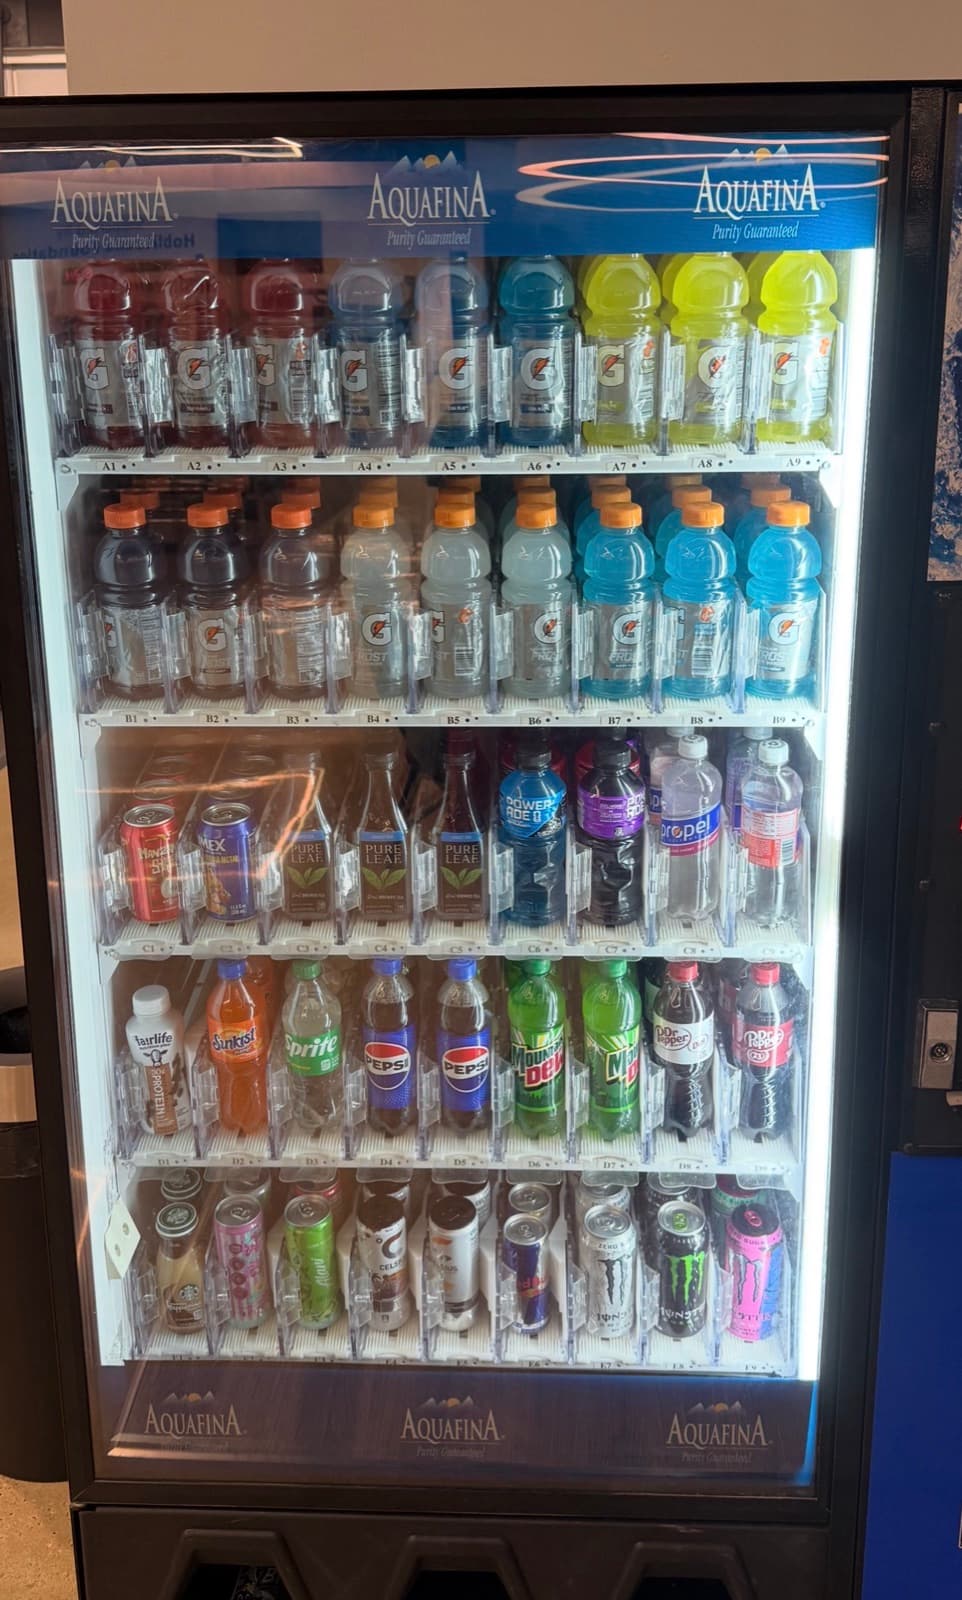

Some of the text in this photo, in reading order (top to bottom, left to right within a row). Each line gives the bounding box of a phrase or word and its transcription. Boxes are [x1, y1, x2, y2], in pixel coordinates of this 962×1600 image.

[693, 163, 821, 220] AQUAFINA
[51, 176, 174, 230] AQUAFINA
[368, 170, 490, 226] AQUAFINA
[712, 221, 799, 243] Purity Guaranteed
[387, 227, 472, 249] Purity Guaranteed
[102, 461, 116, 471] A1
[187, 461, 202, 471] A2
[272, 461, 287, 471] A3
[357, 460, 372, 471] A4
[441, 460, 456, 471] A5
[527, 460, 542, 471] A6
[612, 460, 627, 471] A7
[697, 458, 713, 468] A8
[786, 457, 801, 467] A9
[125, 714, 137, 723] B1
[206, 714, 219, 723] B2
[287, 715, 300, 724] B3
[367, 714, 380, 723] B4
[447, 715, 460, 724] B5
[528, 716, 542, 725] B6
[608, 715, 621, 725] B7
[690, 715, 704, 725] B8
[506, 796, 552, 810] POWER
[661, 814, 710, 841] propel
[291, 843, 322, 854] PURE
[365, 844, 401, 854] PURE
[445, 844, 480, 854] PURE
[366, 855, 402, 865] LEAF
[445, 855, 481, 864] LEAF
[135, 1032, 173, 1047] fairlife
[213, 1026, 257, 1051] Sunkist
[285, 1033, 338, 1058] Sprite
[152, 1075, 166, 1116] PROTEIN
[232, 1157, 245, 1166] D2
[379, 1157, 393, 1167] D4
[453, 1158, 467, 1167] D5
[528, 1159, 541, 1168] D6
[604, 1160, 616, 1169] D7
[144, 1404, 242, 1440] AQUAFINA
[400, 1408, 500, 1444] AQUAFINA
[666, 1413, 768, 1450] AQUAFINA
